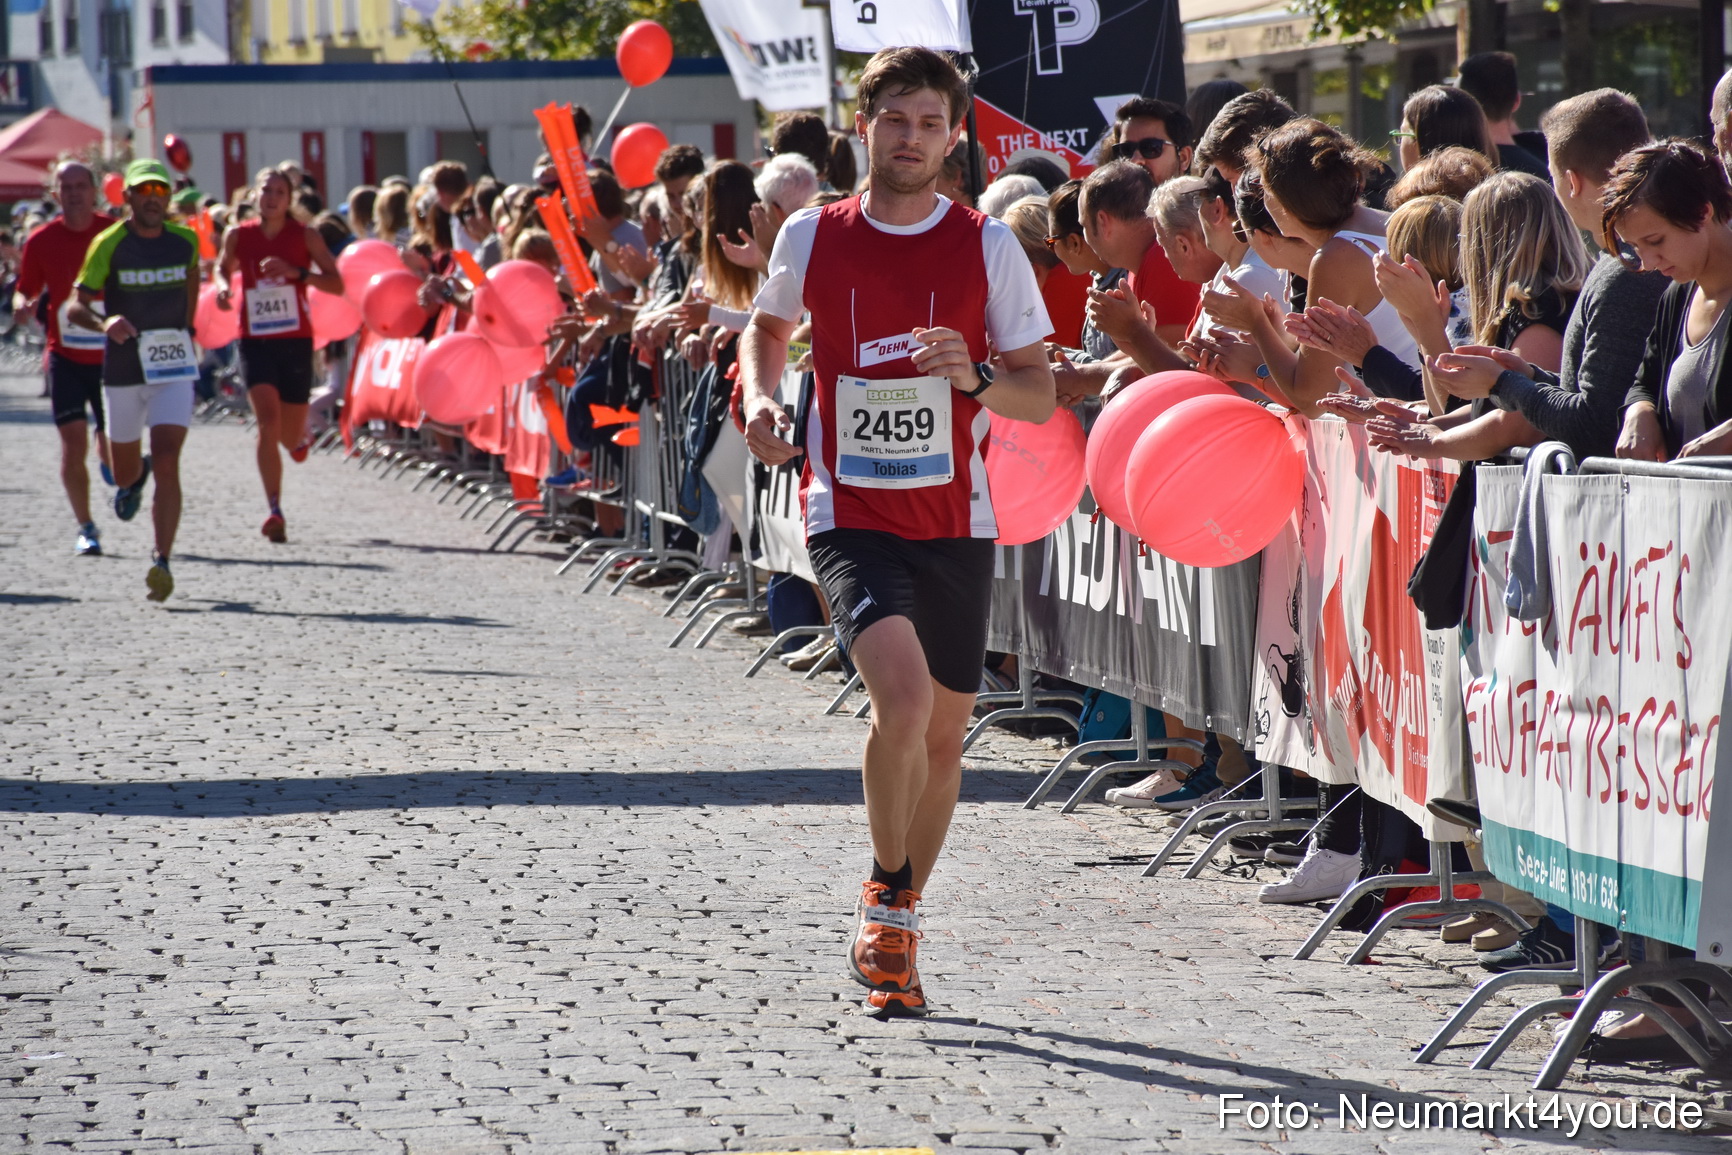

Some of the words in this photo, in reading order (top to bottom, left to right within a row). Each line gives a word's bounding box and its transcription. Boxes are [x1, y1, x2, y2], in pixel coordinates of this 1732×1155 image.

[996, 133, 1034, 153] THE
[1039, 128, 1089, 150] NEXT
[117, 265, 188, 286] BOCK
[254, 299, 289, 316] 2441
[148, 343, 187, 363] 2526
[878, 340, 909, 356] DEHN
[866, 388, 918, 401] BOCK
[852, 407, 935, 443] 2459
[860, 445, 884, 454] PARTL
[885, 446, 920, 455] Neumarkt
[872, 461, 918, 477] Tobias
